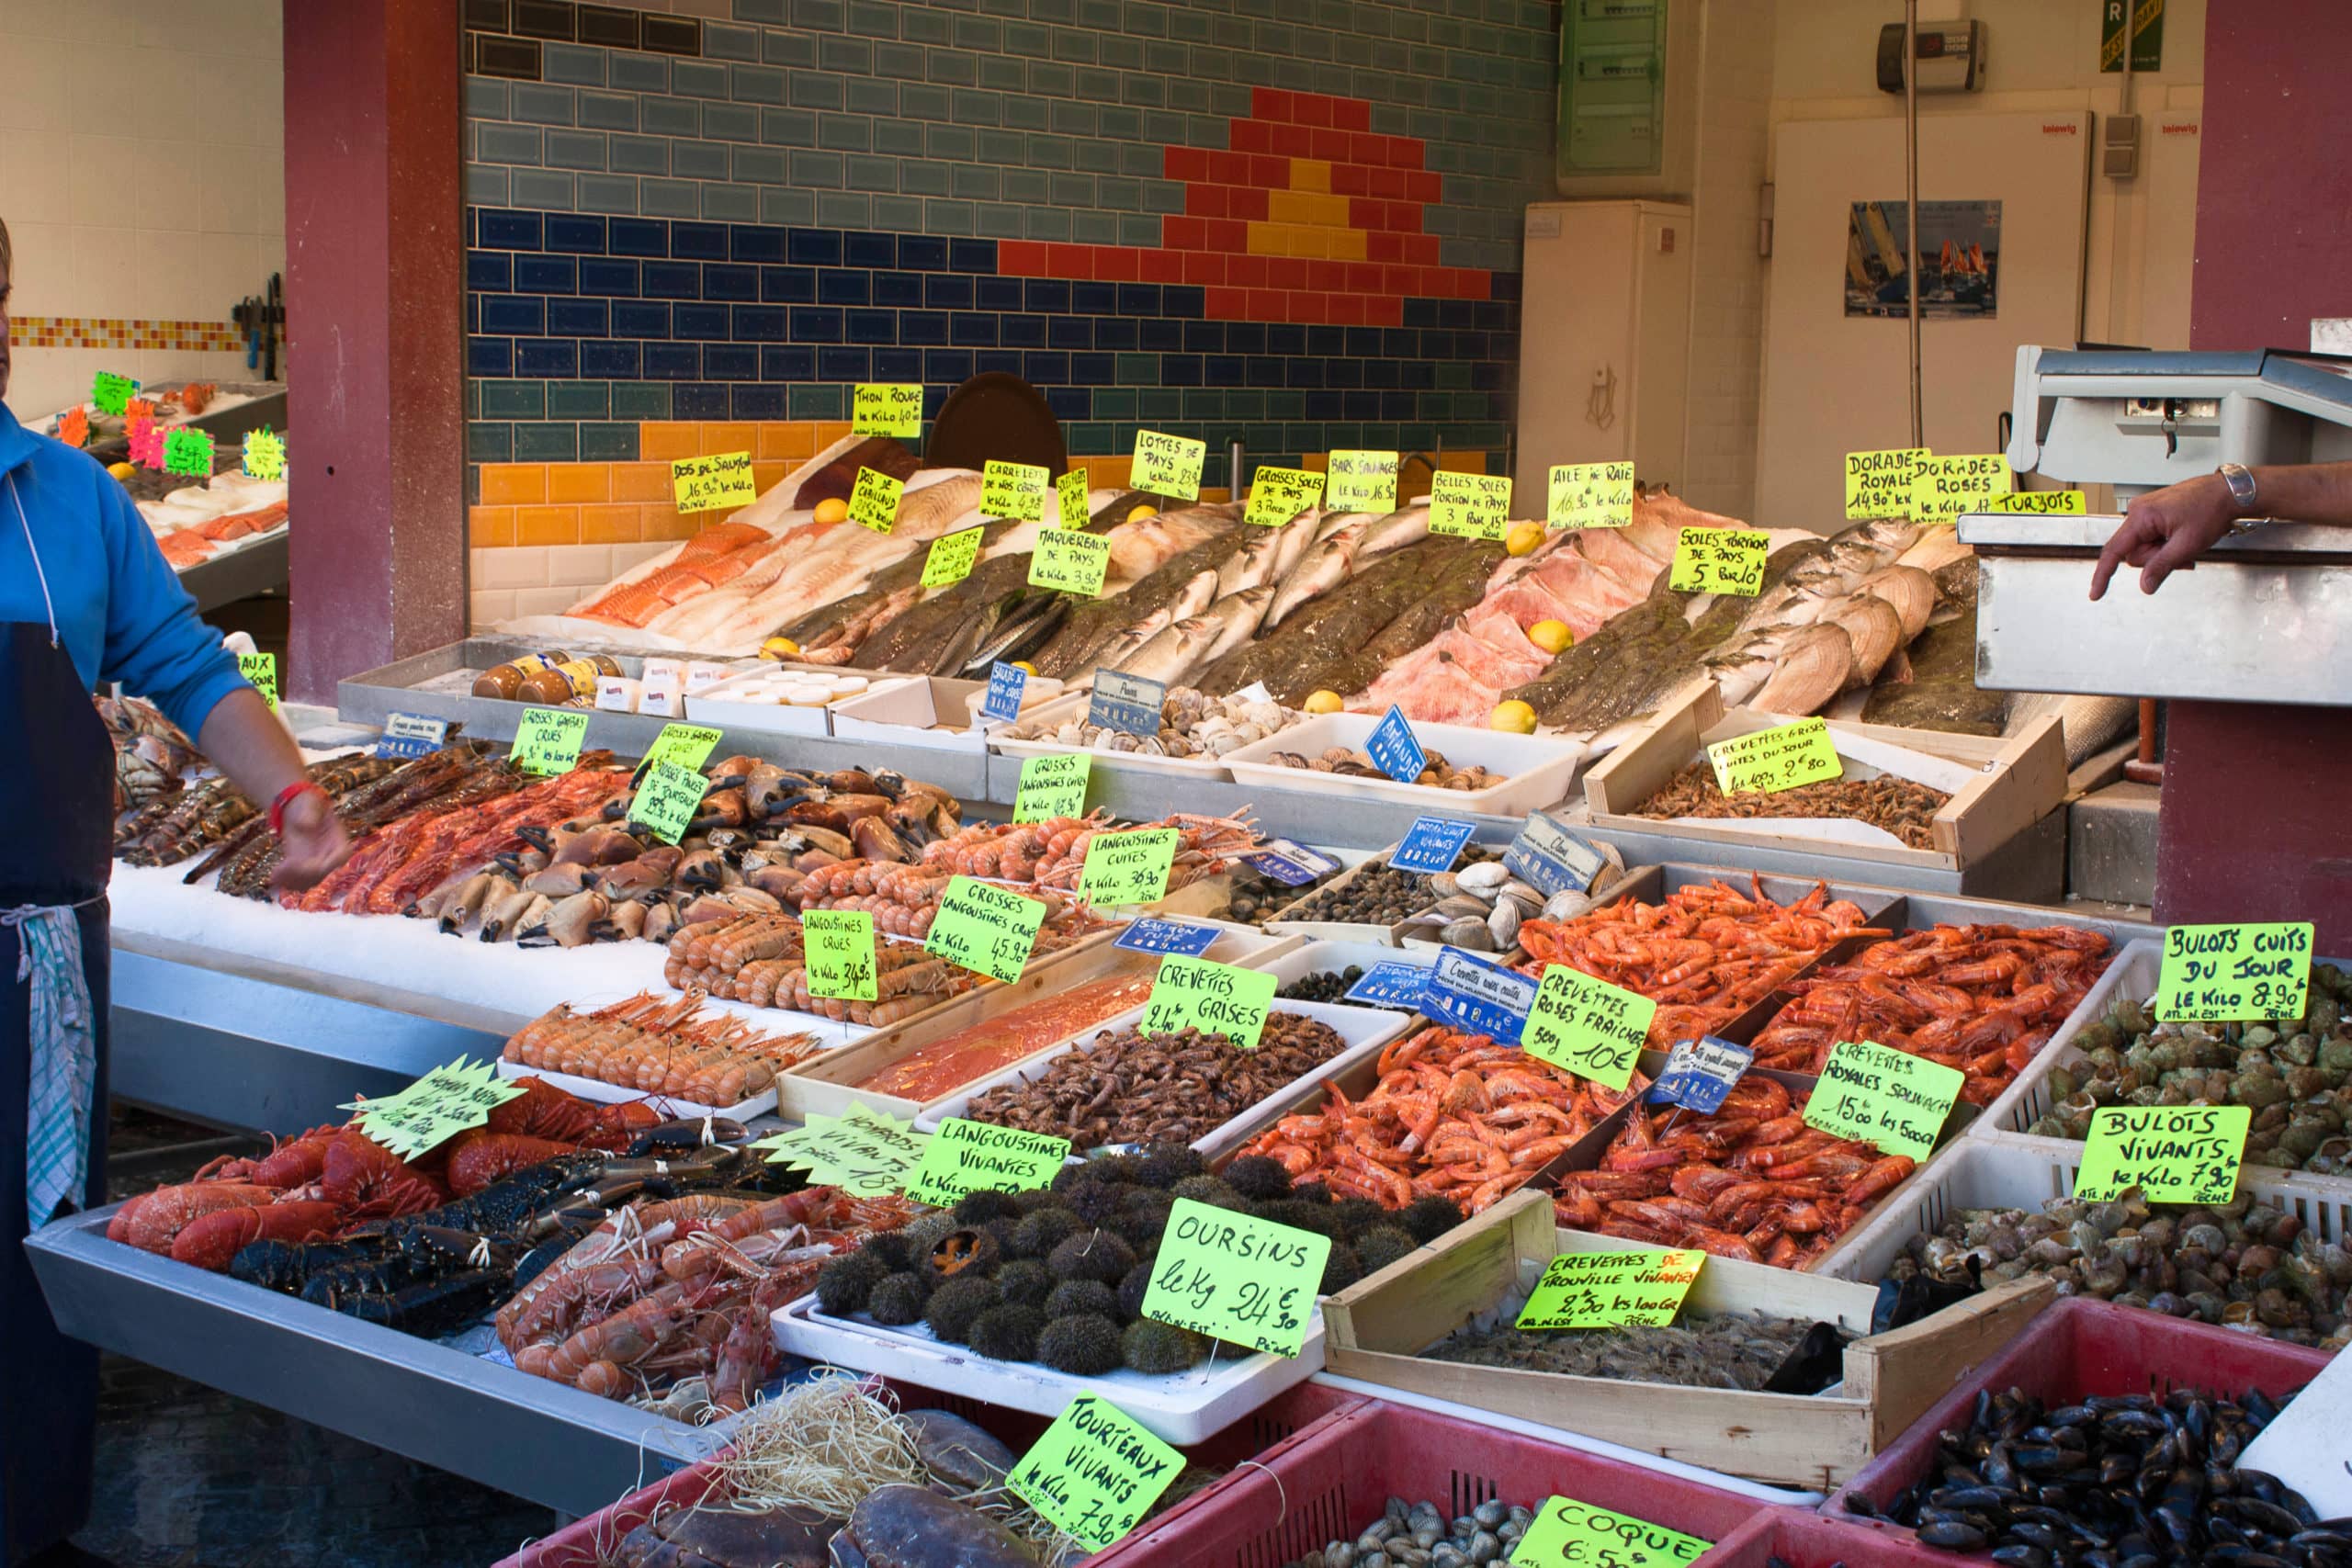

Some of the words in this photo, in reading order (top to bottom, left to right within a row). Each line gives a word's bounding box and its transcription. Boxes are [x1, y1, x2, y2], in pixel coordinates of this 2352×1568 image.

[855, 387, 883, 403] THON
[1139, 433, 1182, 455] LOTTES
[674, 465, 695, 479] DOS
[698, 464, 712, 477] DE
[1144, 451, 1175, 471] PAYS
[1257, 468, 1296, 486] GROSSES
[1297, 474, 1324, 491] SOLES
[1434, 473, 1473, 488] BELLES
[1478, 478, 1508, 493] SOLES
[1553, 468, 1581, 485] AILE
[1605, 463, 1634, 481] RAIE
[1936, 478, 1992, 495] ROSES
[1433, 488, 1470, 505] PORTION
[1485, 494, 1508, 512] PAYS
[1446, 508, 1454, 523] 3
[1039, 529, 1111, 552] MAQUEREAUX
[1680, 529, 1720, 548] SOLES
[1069, 550, 1095, 567] PAYS
[1688, 549, 1706, 560] DE
[1714, 547, 1745, 563] PAYS
[1690, 563, 1710, 584] 5
[1713, 732, 1784, 759] CREVETTES
[1788, 721, 1826, 739] GRISES
[1762, 750, 1780, 760] DU
[1781, 738, 1815, 753] JOUR
[1034, 755, 1076, 775] GROSSES
[1094, 831, 1170, 852] LANGOUSTINES
[1106, 849, 1148, 866] CUITES
[967, 884, 1024, 915] GROSSES
[805, 914, 862, 933] LANGOUSTINES
[942, 896, 1008, 930] LANGOUSTINES
[822, 935, 851, 952] CRUES
[2169, 928, 2241, 958] BULOTS
[2253, 926, 2307, 953] CUITS
[1159, 963, 1235, 997] CREVETTES
[2180, 961, 2217, 983] DU
[2233, 955, 2294, 980] JOUR
[1544, 974, 1629, 1018] CREVETTES
[2174, 990, 2195, 1009] LE
[1197, 996, 1261, 1027] GRISES
[1536, 994, 1578, 1024] ROSES
[1836, 1042, 1915, 1076] CREVETTES
[1824, 1059, 1882, 1091] ROYALES
[2101, 1111, 2220, 1136] BULOTS
[942, 1122, 1069, 1162] LANGOUSTINES
[2119, 1136, 2230, 1161] VIVANTS
[959, 1149, 1037, 1178] VIVANTES
[1176, 1215, 1308, 1268] OURSINS
[1549, 1254, 1648, 1272] CREVETTES
[1542, 1271, 1625, 1288] TROUVILLE
[1069, 1397, 1169, 1480] TOURTEAUX
[1065, 1444, 1138, 1504] VIVANTS
[1556, 1505, 1708, 1560] COQUE
